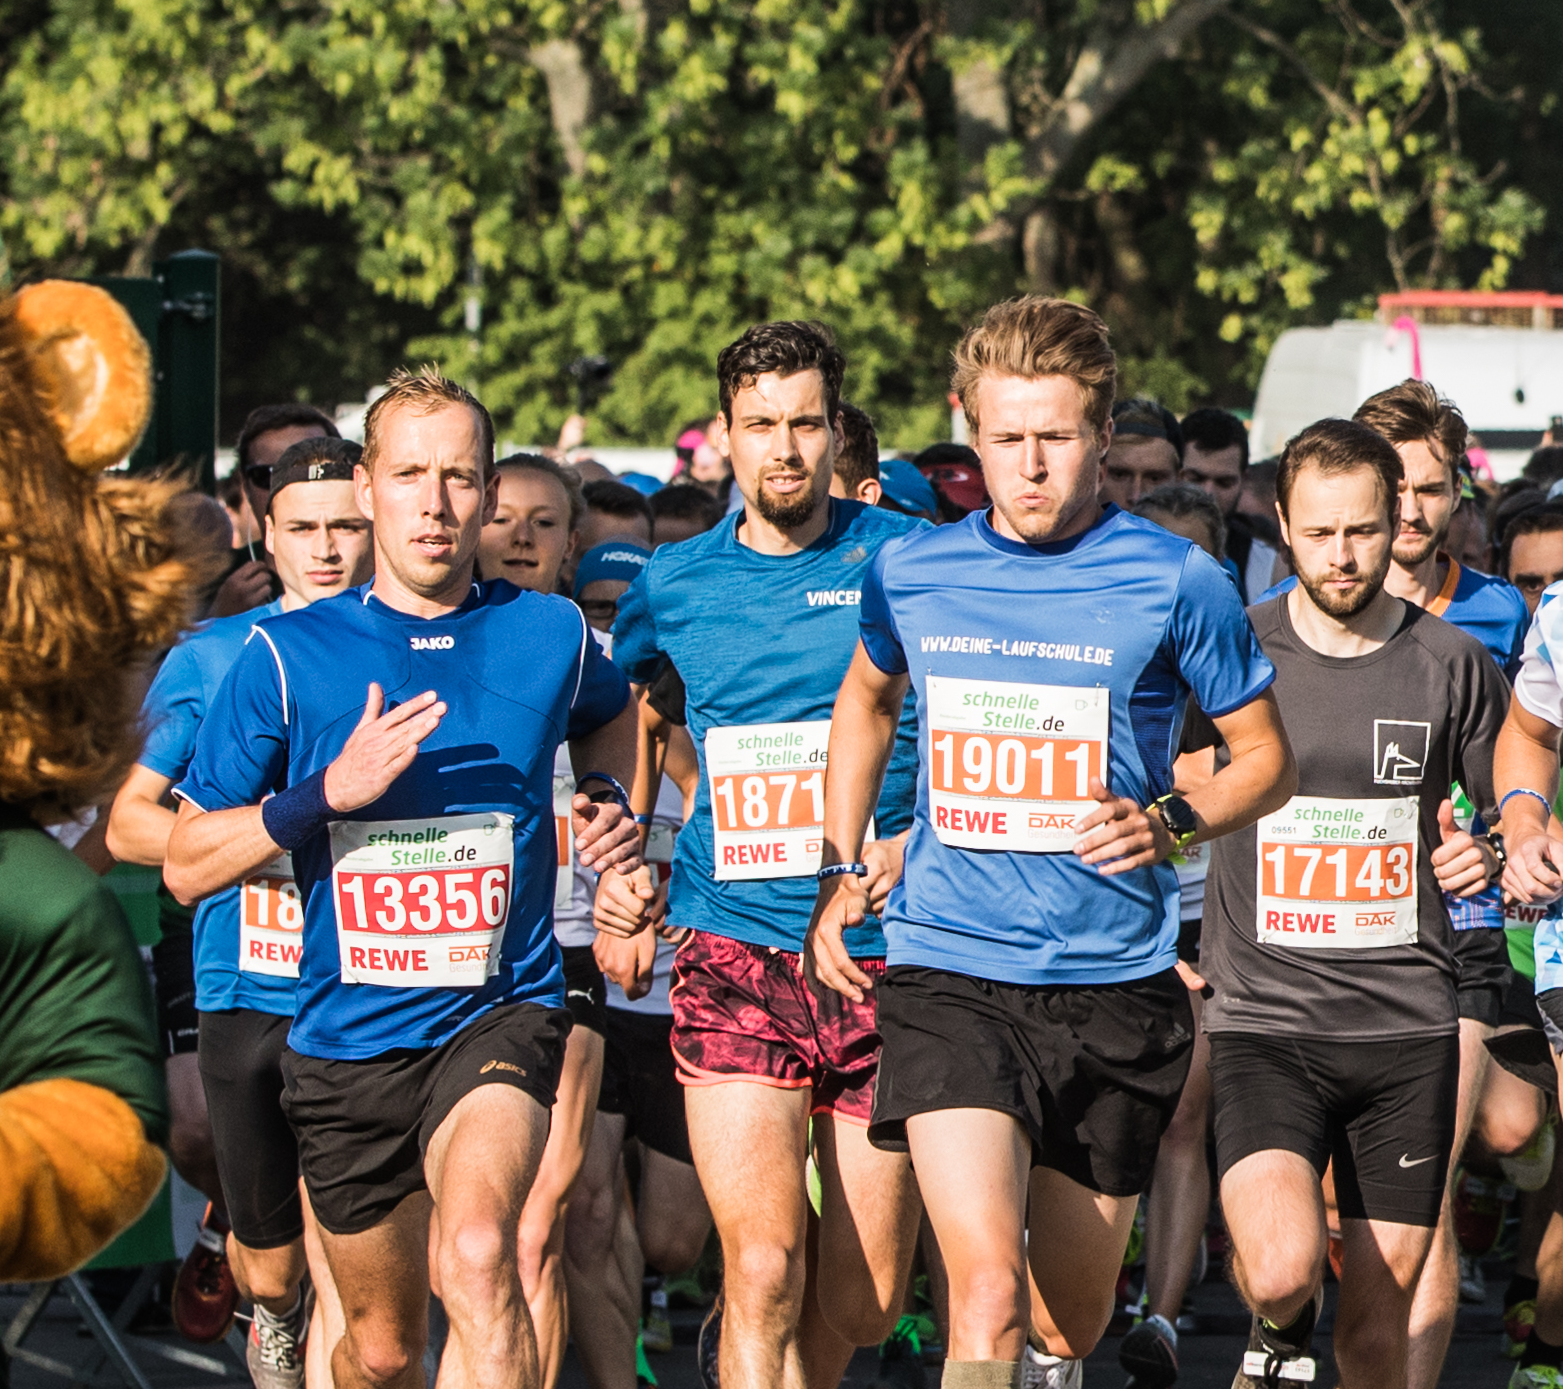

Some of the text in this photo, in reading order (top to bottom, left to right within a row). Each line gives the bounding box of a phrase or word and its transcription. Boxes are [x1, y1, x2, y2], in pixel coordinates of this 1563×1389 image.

[409, 635, 456, 650] JAKO
[920, 635, 1115, 666] WWW.DEINE-LAUFSCHULE.DE
[961, 690, 1040, 711] schnelle
[982, 710, 1066, 732] Stelle.de
[737, 731, 804, 750] schnelle
[755, 747, 828, 767] Stelle.de
[934, 733, 1090, 798] 19011
[936, 805, 1008, 835] REWE
[1027, 811, 1076, 830] DAK
[1294, 806, 1365, 822] schnelle
[366, 827, 449, 847] schnelle
[1311, 824, 1388, 841] Stelle.de
[390, 845, 477, 867] Stelle.de
[722, 842, 788, 866] REWE
[1264, 844, 1410, 899] 17143
[341, 868, 507, 932] 13356
[1265, 910, 1337, 934] REWE
[1354, 911, 1397, 927] DAK
[349, 946, 430, 972] REWE
[448, 943, 493, 963] DAK
